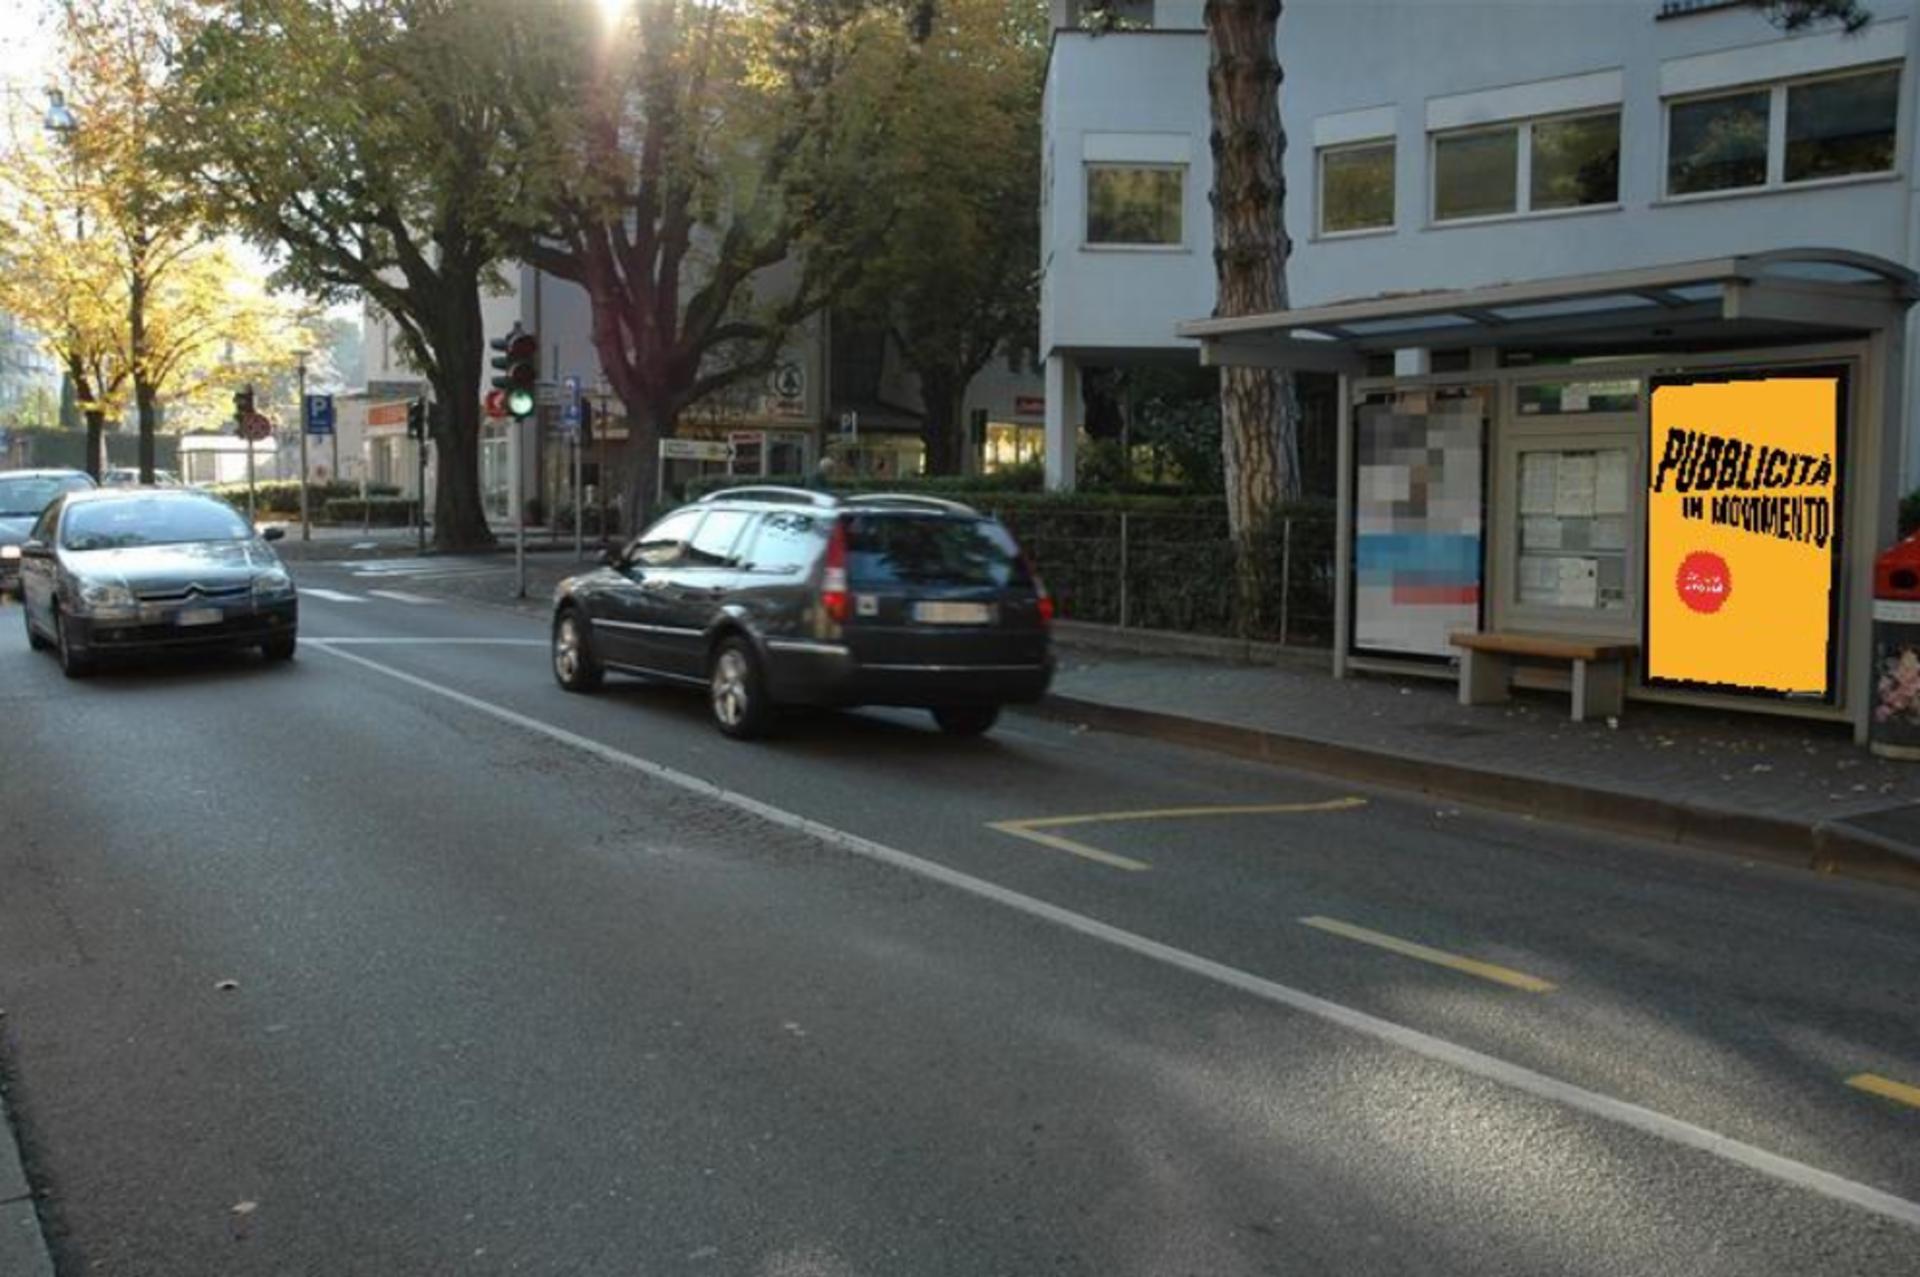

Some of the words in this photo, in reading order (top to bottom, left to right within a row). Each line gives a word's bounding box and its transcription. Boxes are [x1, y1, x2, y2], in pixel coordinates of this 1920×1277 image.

[311, 397, 327, 417] P
[1654, 426, 1832, 492] PUBBLICITÀ
[1682, 497, 1703, 519] IN
[1711, 494, 1830, 548] MOVIMENTO
